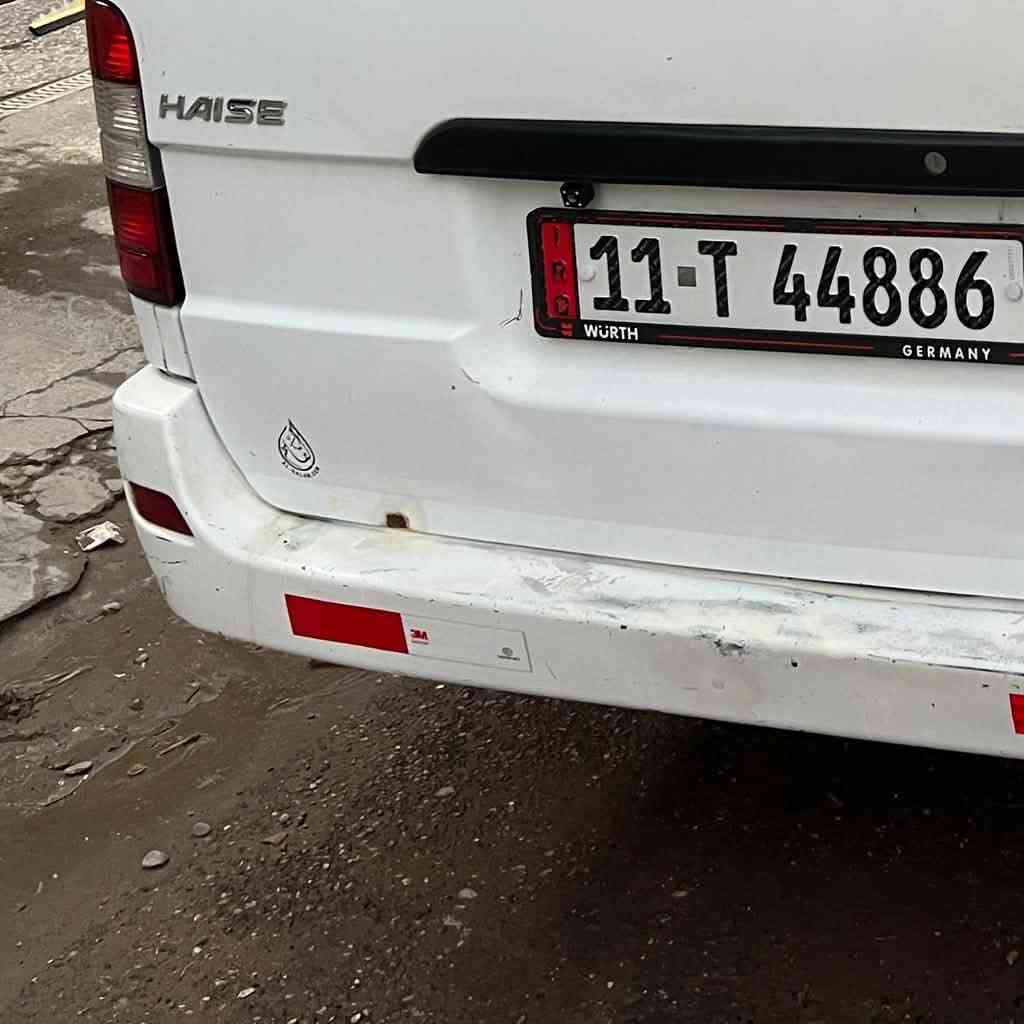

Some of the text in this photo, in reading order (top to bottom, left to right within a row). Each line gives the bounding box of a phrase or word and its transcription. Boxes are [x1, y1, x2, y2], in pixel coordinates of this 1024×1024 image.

[159, 93, 288, 126] HAISE
[772, 244, 995, 331] 44886
[583, 324, 640, 341] WÜRTH
[902, 344, 992, 361] GERMANY
